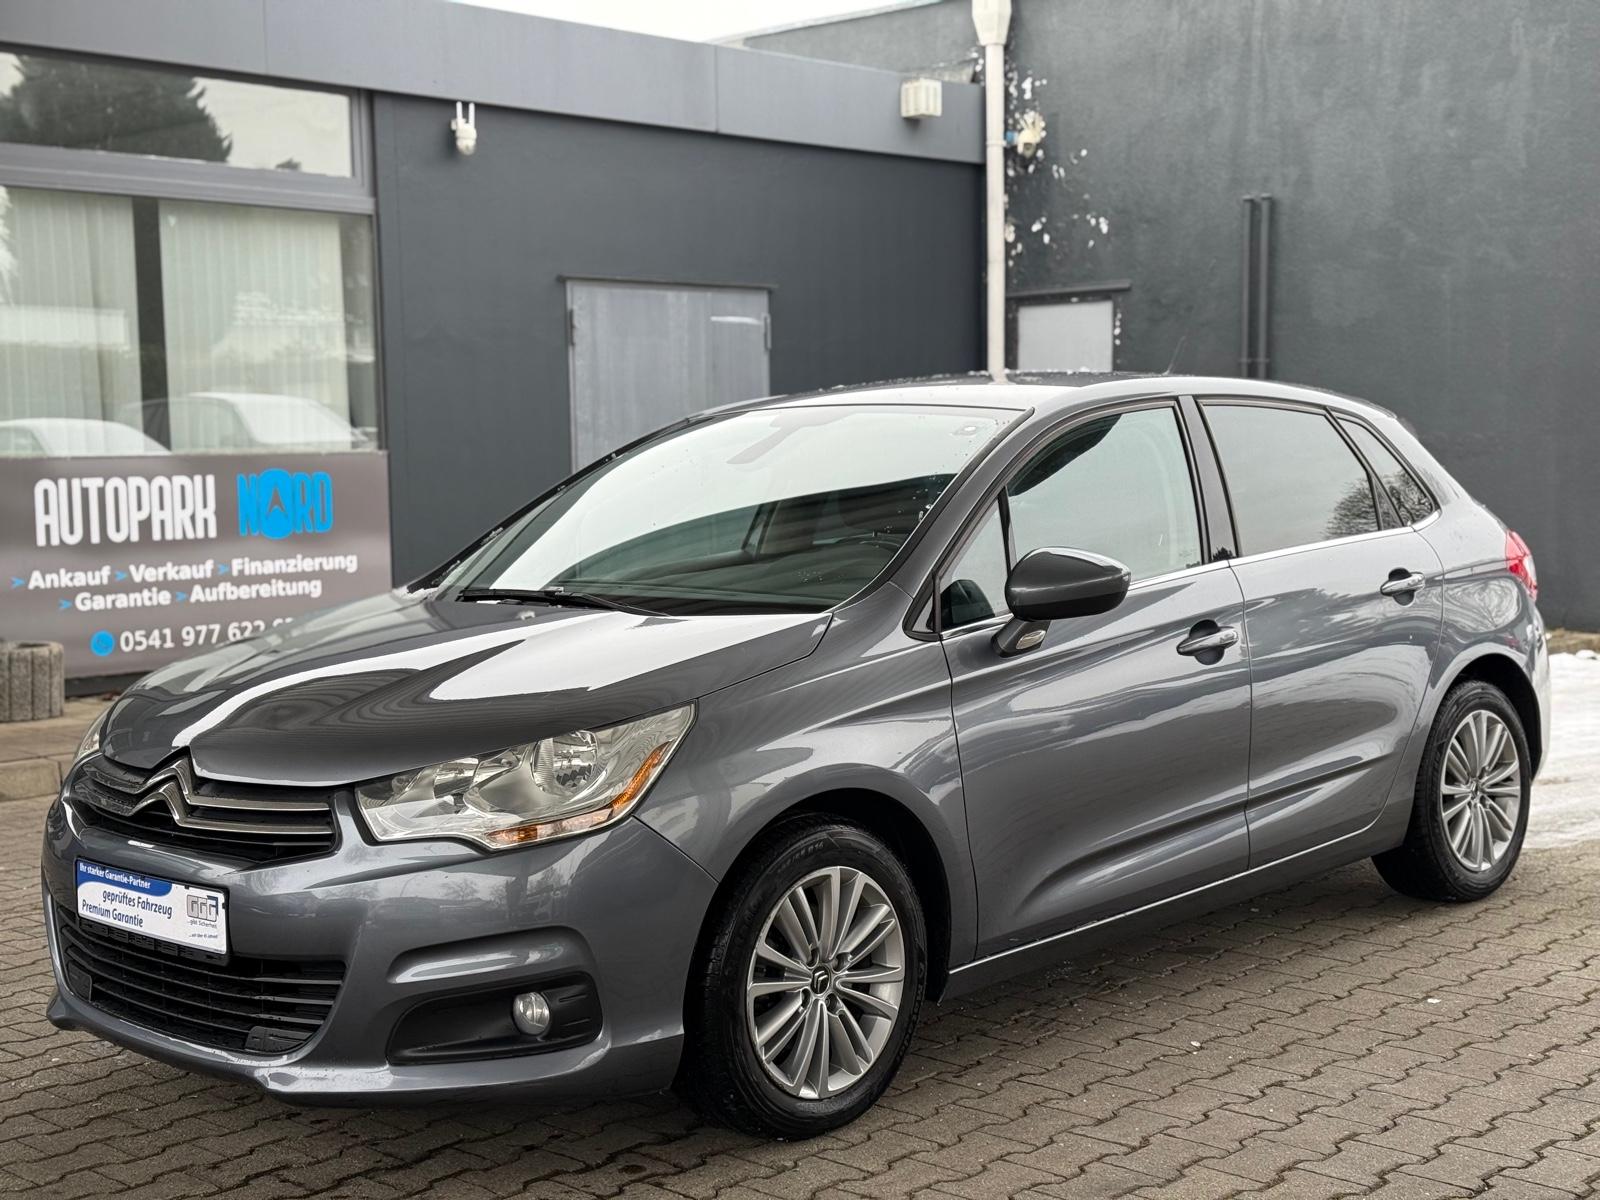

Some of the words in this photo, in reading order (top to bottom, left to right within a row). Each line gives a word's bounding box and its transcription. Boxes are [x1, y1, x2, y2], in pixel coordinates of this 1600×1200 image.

[34, 474, 217, 547] AUTOPARK
[28, 565, 112, 590] Ankauf
[129, 559, 215, 584] Verkauf
[231, 553, 358, 577] Finanzierung
[75, 587, 172, 612] Garantie
[190, 579, 322, 603] Aufbereitung
[119, 627, 175, 652] 0541
[181, 623, 221, 647] 977
[79, 862, 87, 872] Ihr
[87, 864, 105, 878] starker
[105, 870, 151, 889] Garantie-Partner
[82, 899, 111, 920] Premium
[111, 907, 144, 928] Garantie
[102, 889, 136, 908] geprüftes
[136, 896, 173, 919] Fahrzeug
